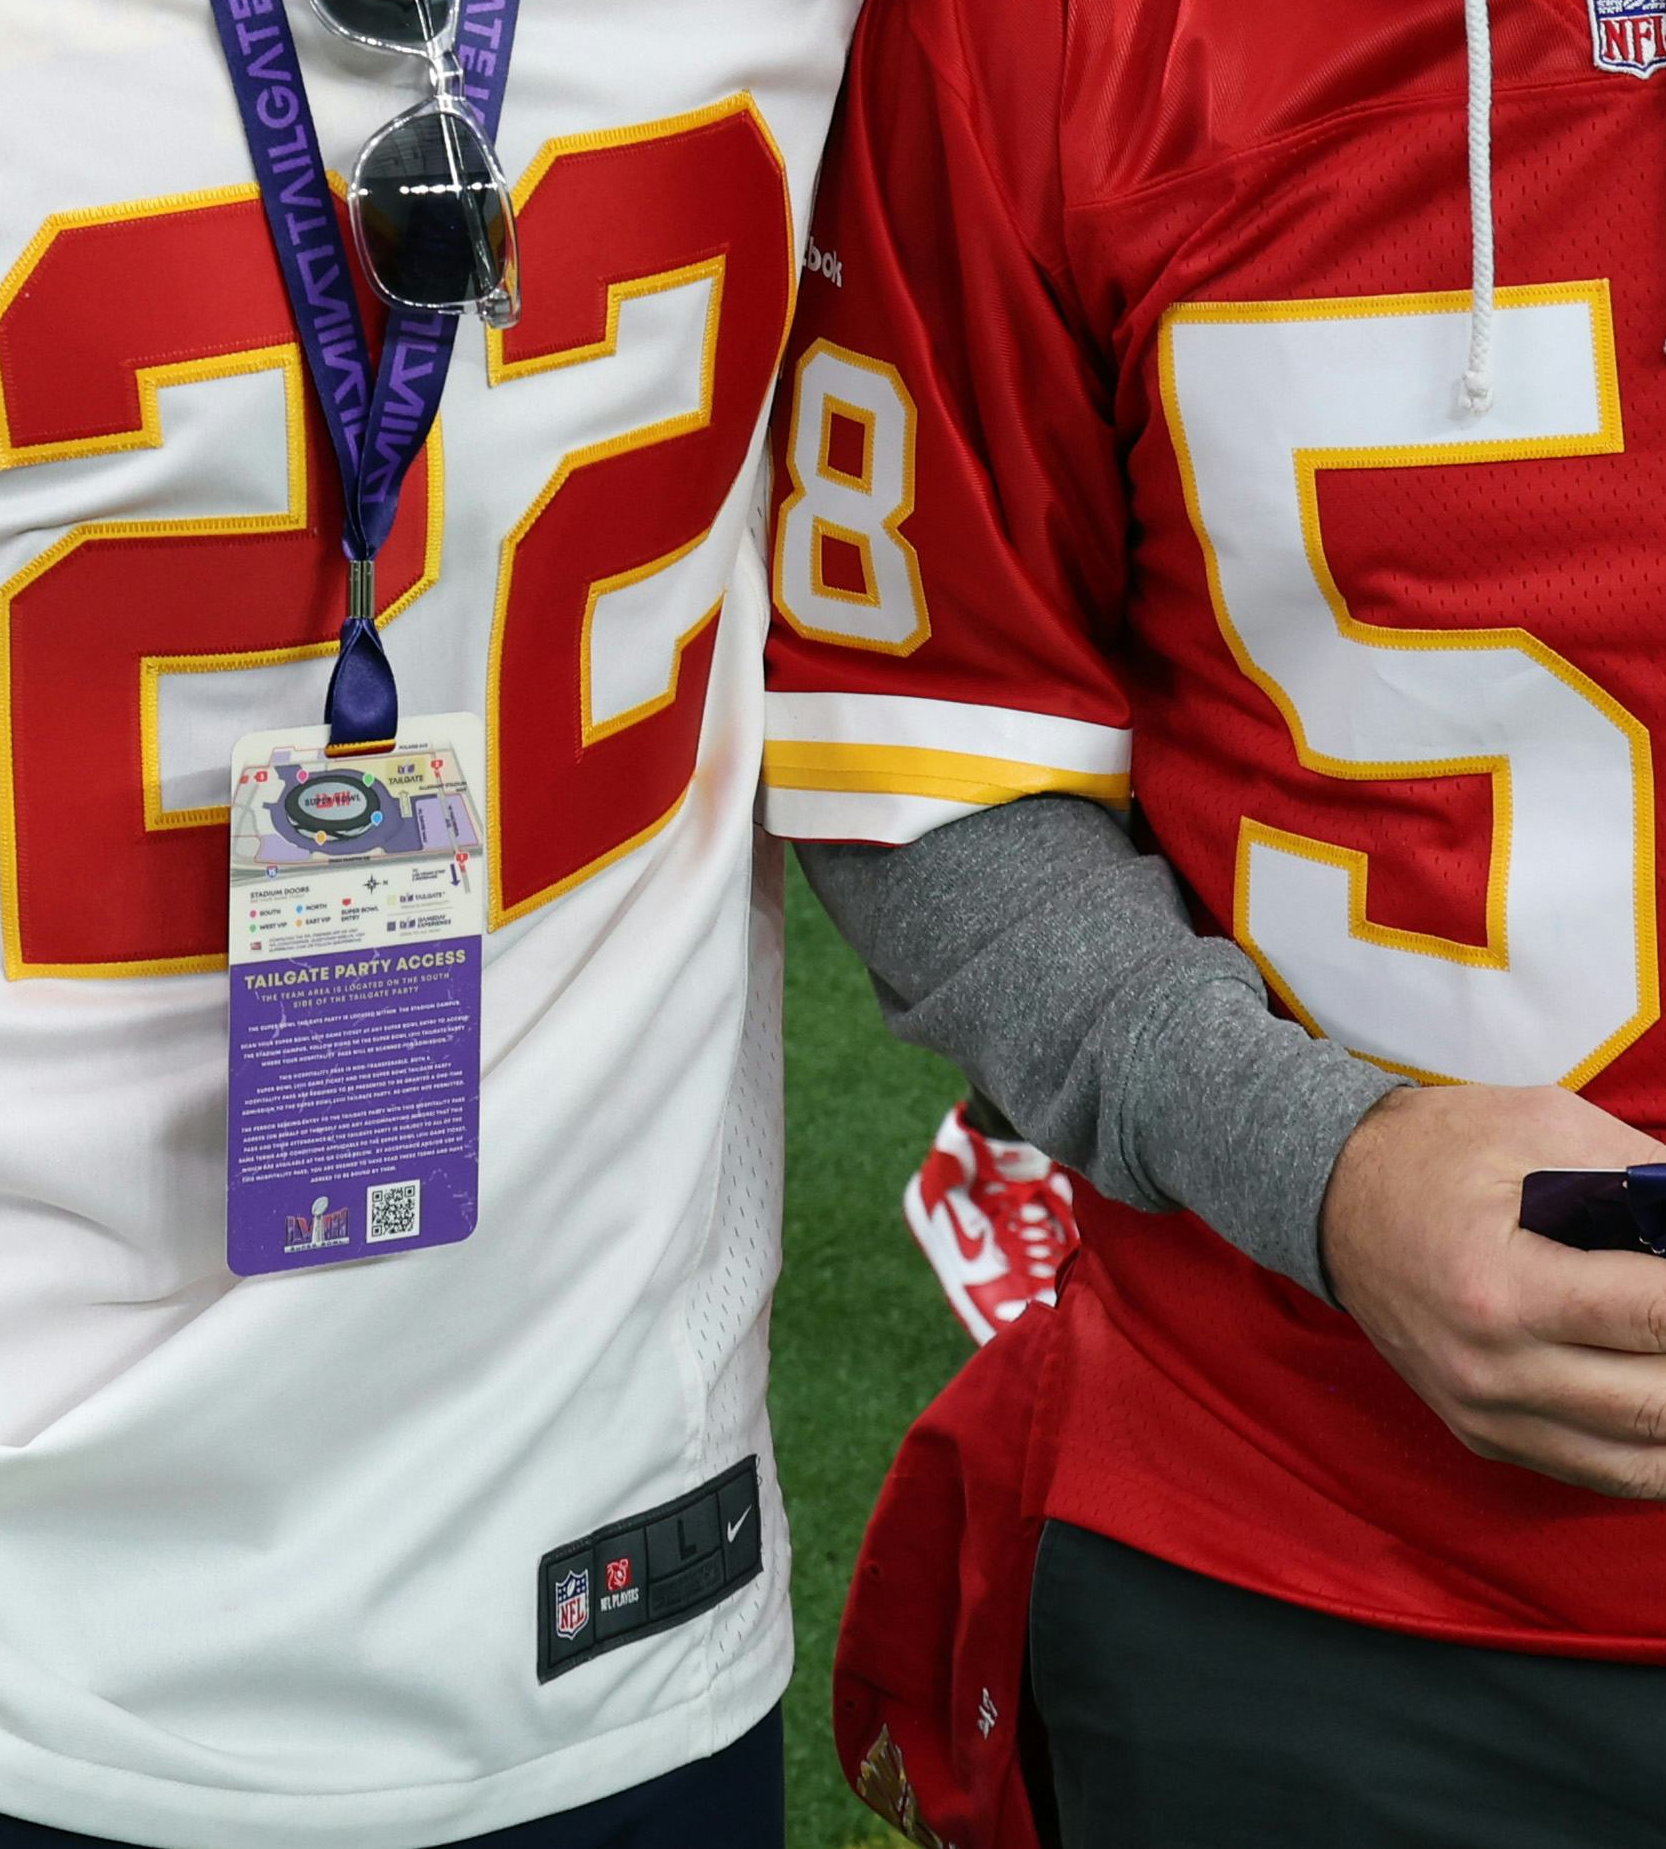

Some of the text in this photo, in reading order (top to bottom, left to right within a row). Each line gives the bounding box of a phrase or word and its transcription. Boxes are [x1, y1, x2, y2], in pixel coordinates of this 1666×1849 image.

[804, 236, 842, 288] bok
[769, 337, 932, 657] 8
[389, 775, 424, 785] TAILGATE
[250, 889, 283, 899] STADIUM
[284, 886, 310, 896] DOORS
[306, 903, 327, 911] NORTH
[341, 906, 379, 916] SUPER BOWL
[260, 921, 287, 931] WEST VIP
[306, 916, 331, 926] EAST VIP
[341, 915, 360, 923] ENTRY
[244, 949, 466, 989] TAILGATE PARTY ACCESS
[262, 993, 278, 1002] THE
[280, 990, 306, 999] TEAM
[308, 987, 331, 996] AREA
[343, 980, 384, 991] LOCATED
[386, 978, 399, 986] ON
[402, 976, 419, 984] THE
[421, 972, 449, 981] SOUTH
[293, 985, 418, 1008] SIDE OF THE TAILGATE PARTY
[612, 1588, 639, 1609] PLAYERS
[559, 1595, 585, 1629] NFL
